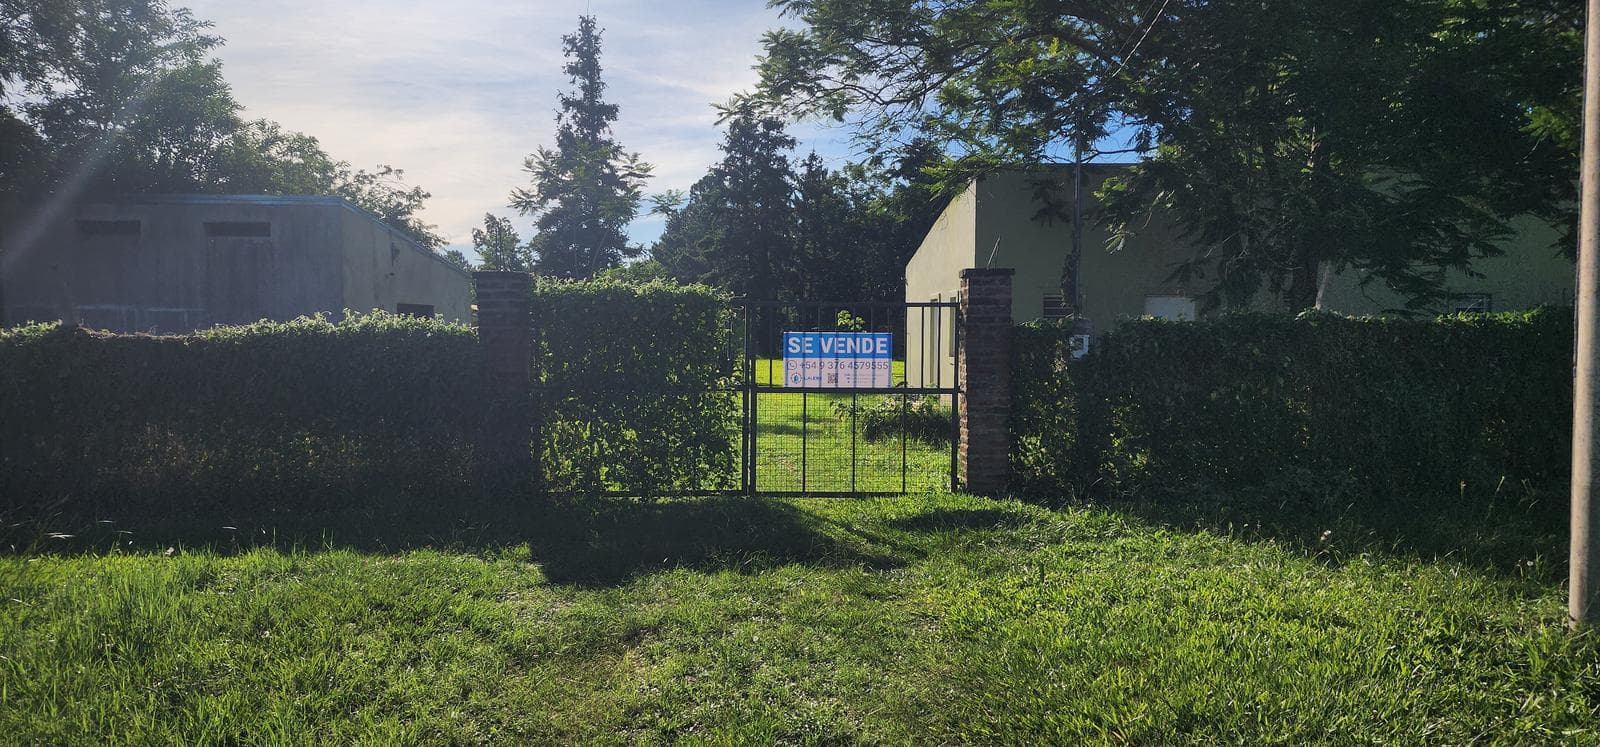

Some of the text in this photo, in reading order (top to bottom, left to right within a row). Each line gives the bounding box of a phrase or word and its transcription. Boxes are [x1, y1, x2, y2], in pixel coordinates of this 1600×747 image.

[788, 336, 888, 354] SE VENDE
[800, 361, 889, 370] +54 9 376 4579555
